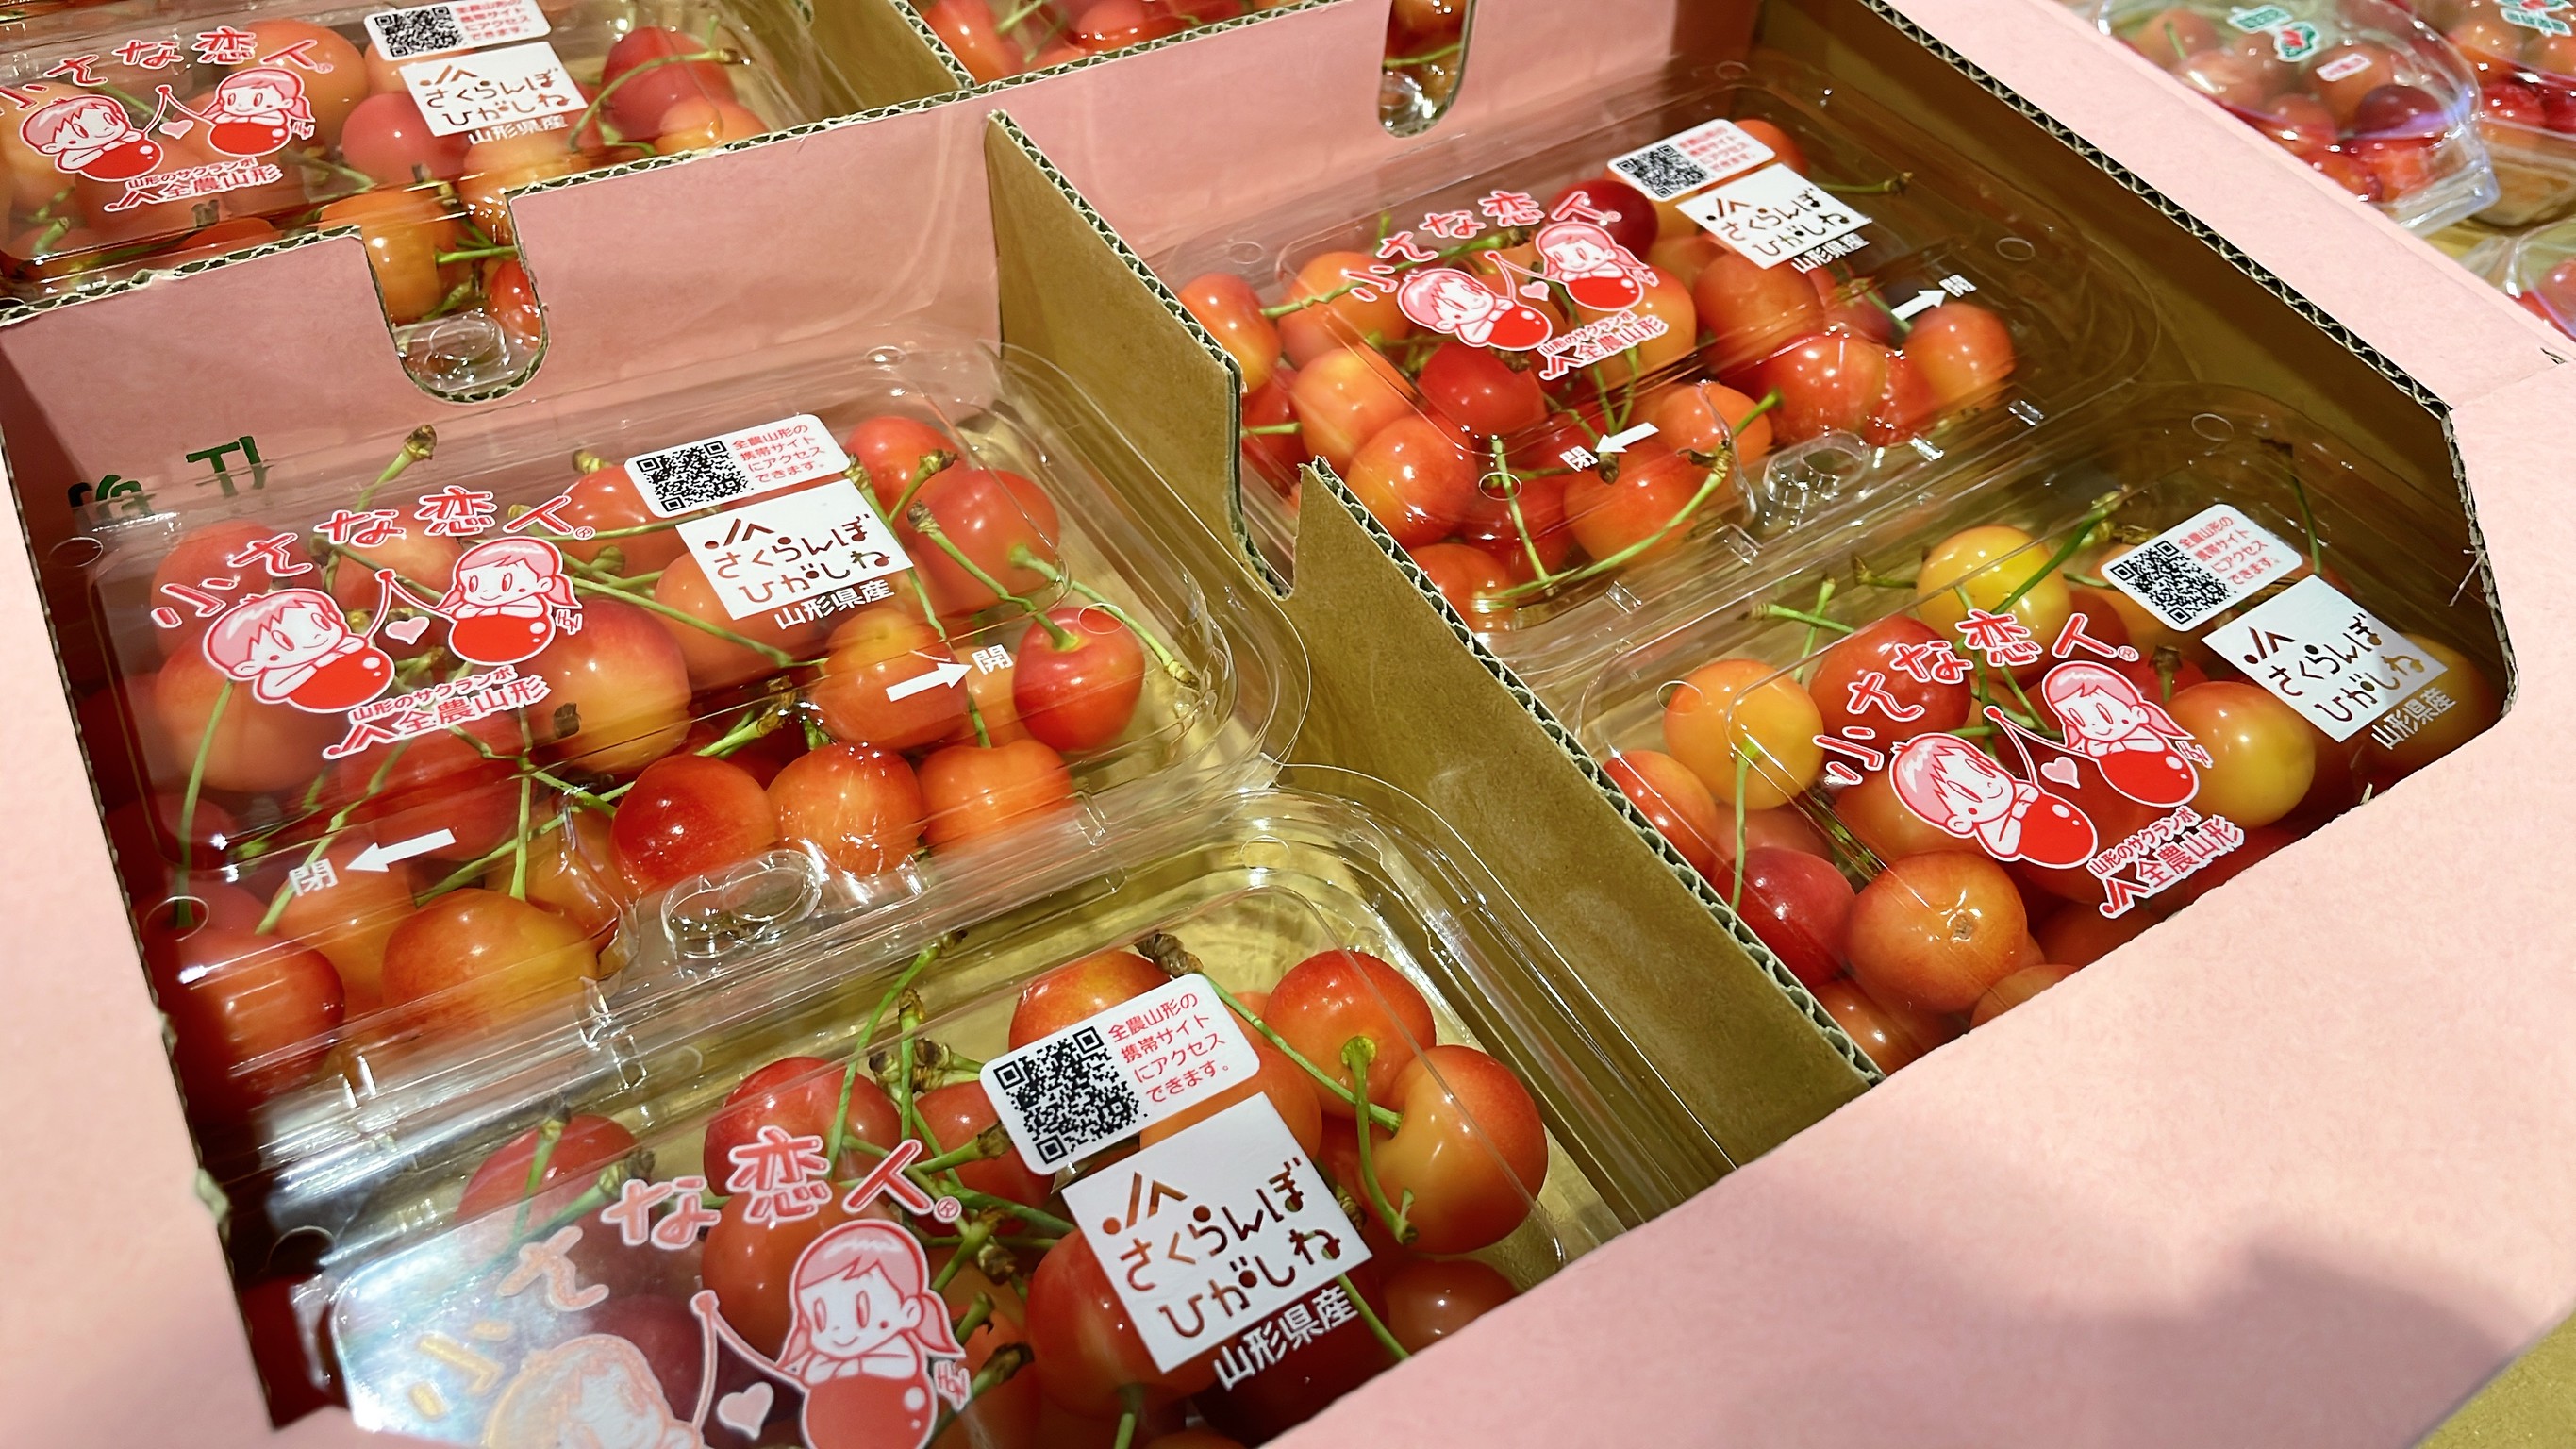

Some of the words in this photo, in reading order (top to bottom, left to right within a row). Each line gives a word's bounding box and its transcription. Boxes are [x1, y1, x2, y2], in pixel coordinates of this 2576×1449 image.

[426, 68, 558, 108] さくらんぼ
[442, 93, 571, 125] ひがしね
[733, 425, 808, 450] 全農山形の
[748, 446, 825, 471] にアクセス
[714, 514, 870, 579] さくらんぼ
[2211, 540, 2269, 572] にアクセス
[739, 551, 890, 603] ひがしね
[773, 579, 894, 629] 山形県産
[971, 644, 1014, 675] 開
[2269, 612, 2383, 697] さくらんぼ
[352, 666, 514, 722] 山形のサクランボ
[2315, 653, 2425, 722] ひがしね
[2370, 687, 2456, 750] 山形県産
[2088, 807, 2201, 875] 山形のサクランボ
[289, 858, 338, 897] 閉
[1107, 991, 1199, 1043] 全農山形の
[1121, 1013, 1211, 1065] 携帯サイト
[1134, 1032, 1226, 1084] にアクセス
[1146, 1060, 1230, 1104] できます。
[1120, 1156, 1304, 1291] さくらんぼ
[1158, 1228, 1342, 1339] ひがしね
[1212, 1284, 1360, 1391] 山形県産
